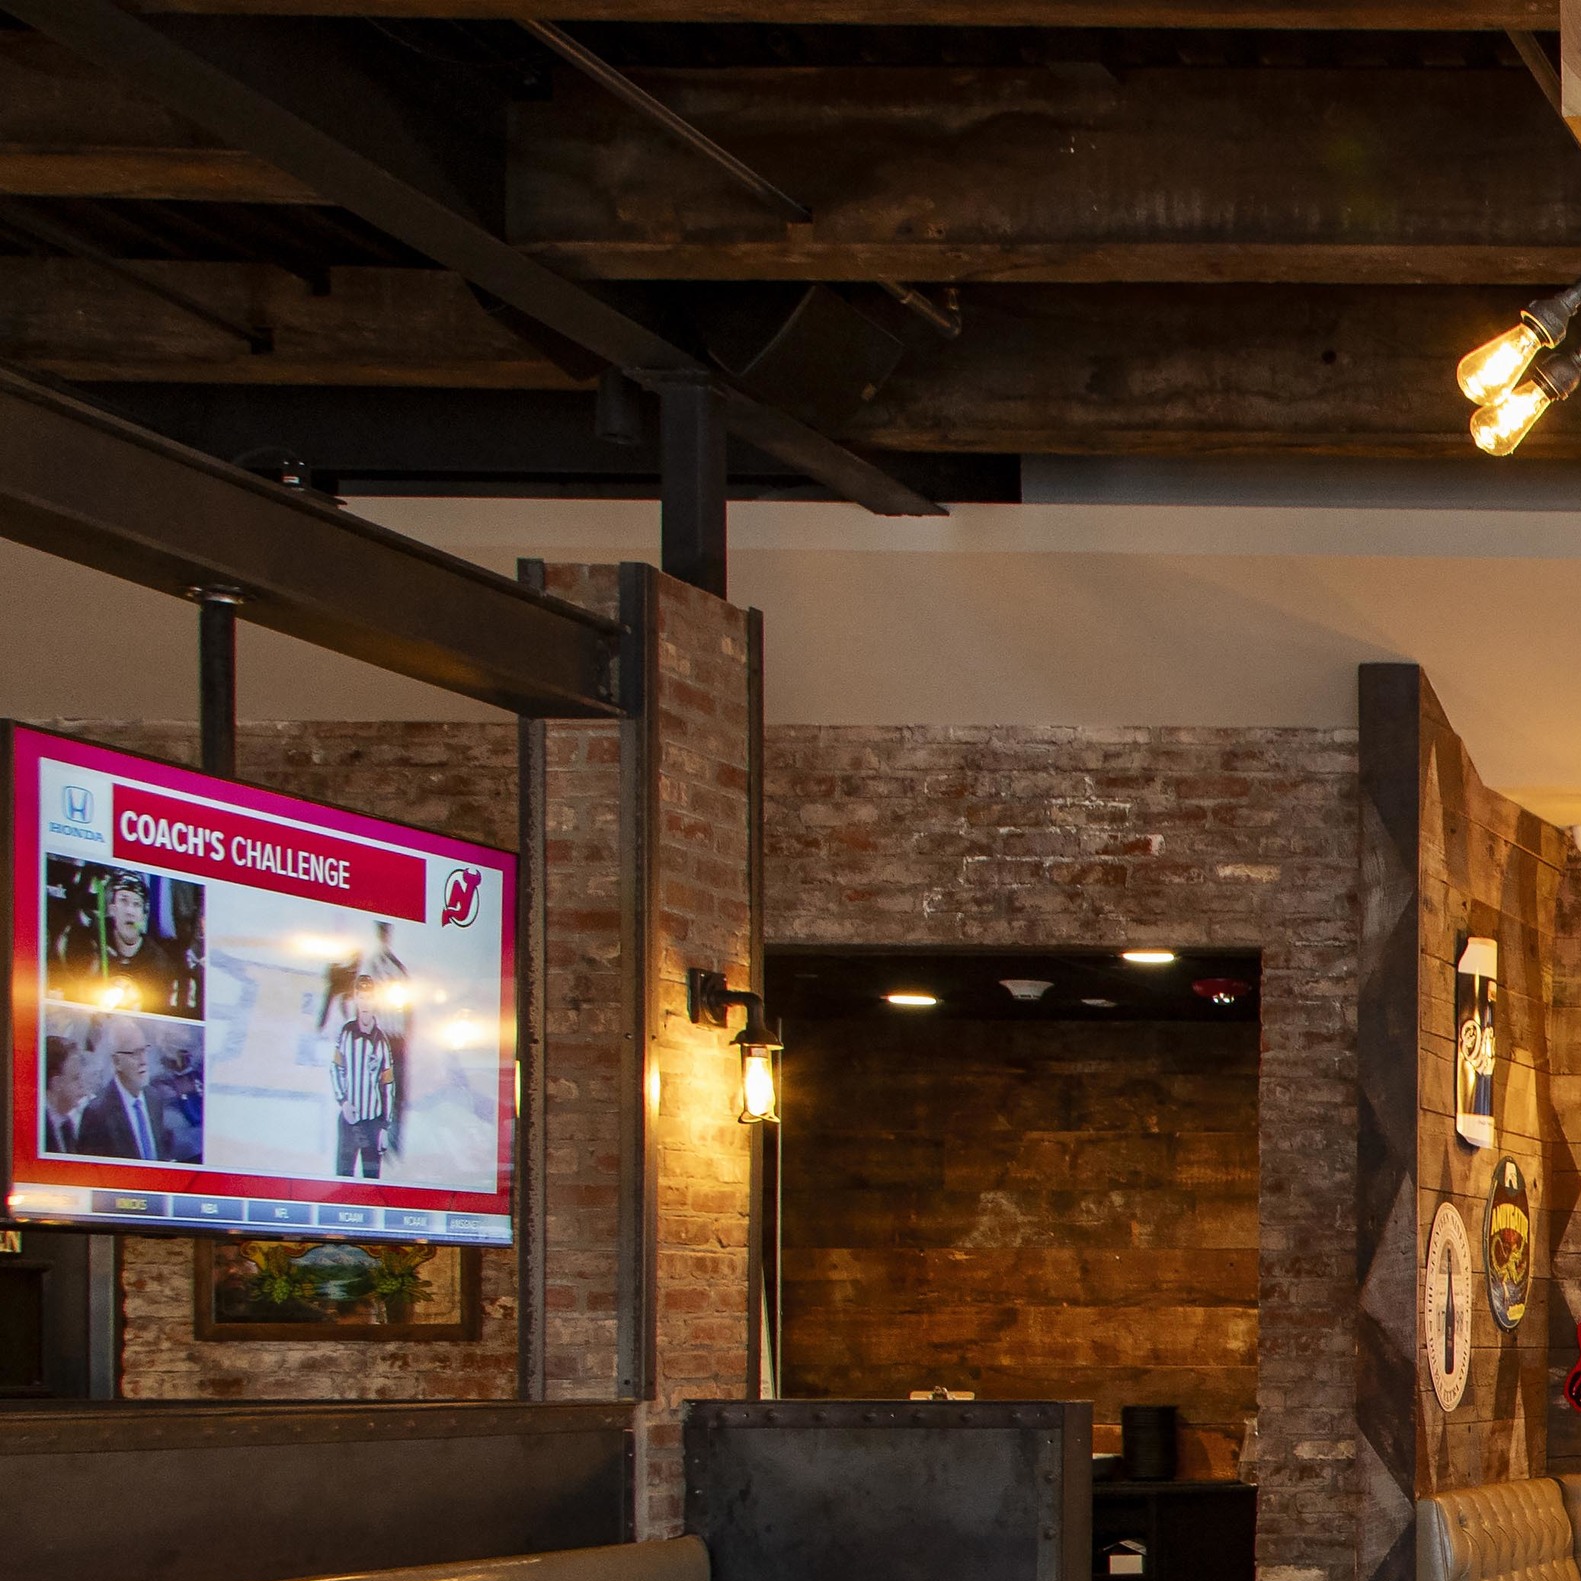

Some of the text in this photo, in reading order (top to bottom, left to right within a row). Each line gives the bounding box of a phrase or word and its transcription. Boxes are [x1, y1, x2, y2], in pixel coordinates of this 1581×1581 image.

[49, 821, 105, 843] HONDA
[120, 810, 350, 889] COACH'S CHALLENGE
